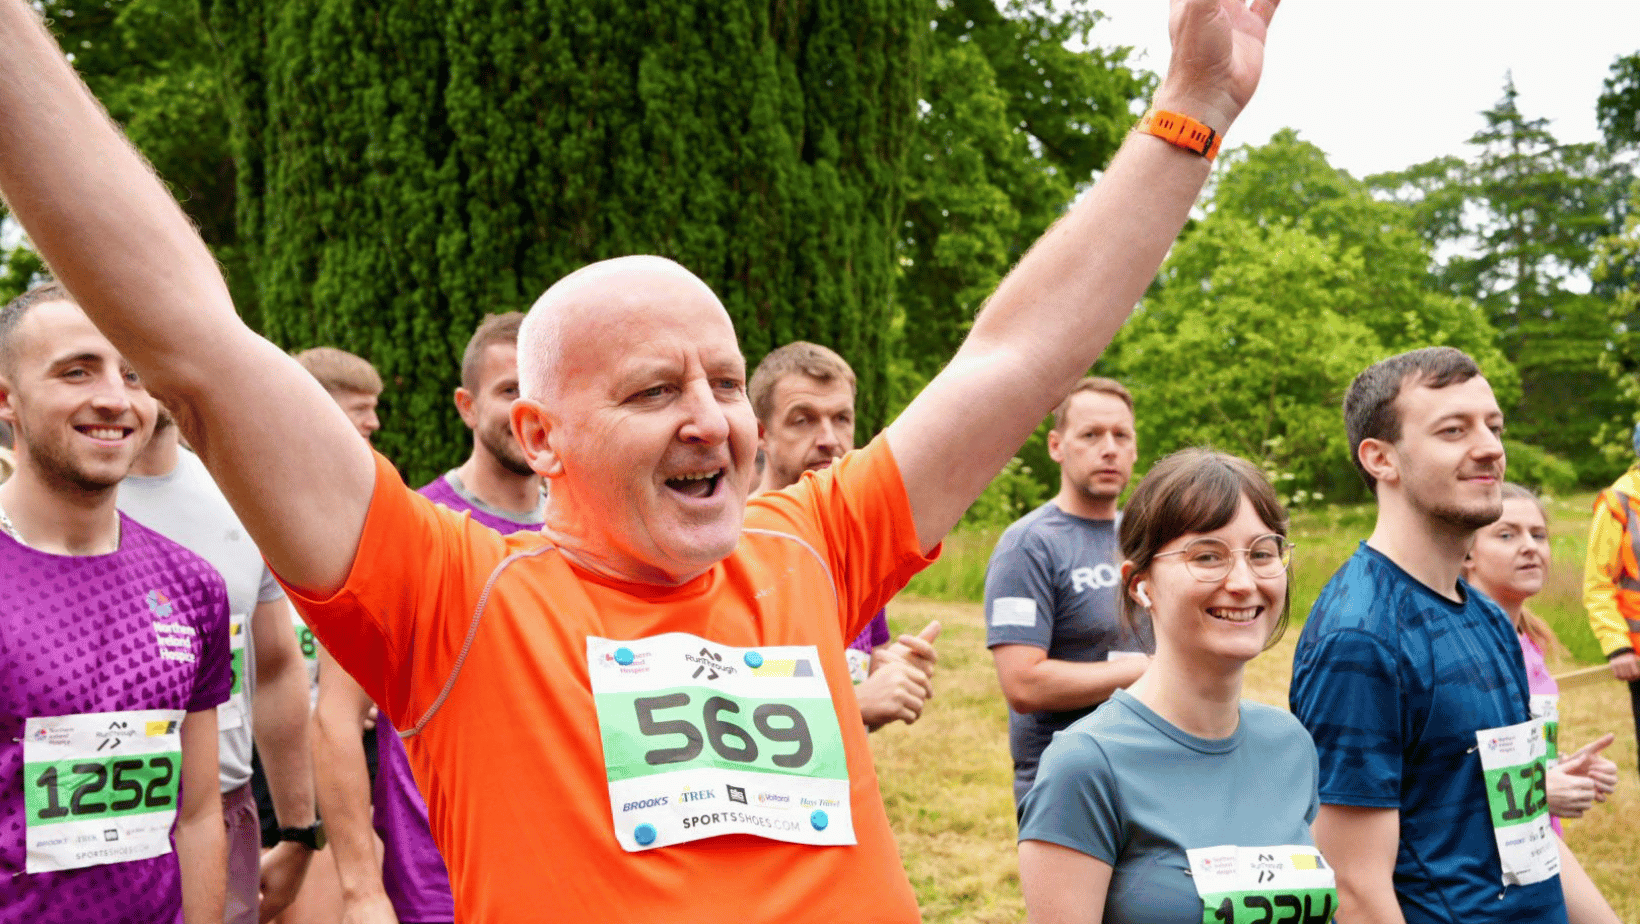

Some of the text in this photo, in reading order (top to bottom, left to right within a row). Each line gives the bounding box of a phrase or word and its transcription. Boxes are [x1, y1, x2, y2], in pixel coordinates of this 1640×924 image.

[1071, 562, 1120, 593] RO
[153, 621, 196, 636] Northern
[156, 634, 191, 648] Ireland
[160, 648, 196, 663] Hospice
[685, 654, 737, 674] RunThrough
[634, 692, 813, 769] 569
[36, 757, 174, 819] 1252
[681, 789, 716, 803] TREK
[623, 796, 669, 812] BROOKS
